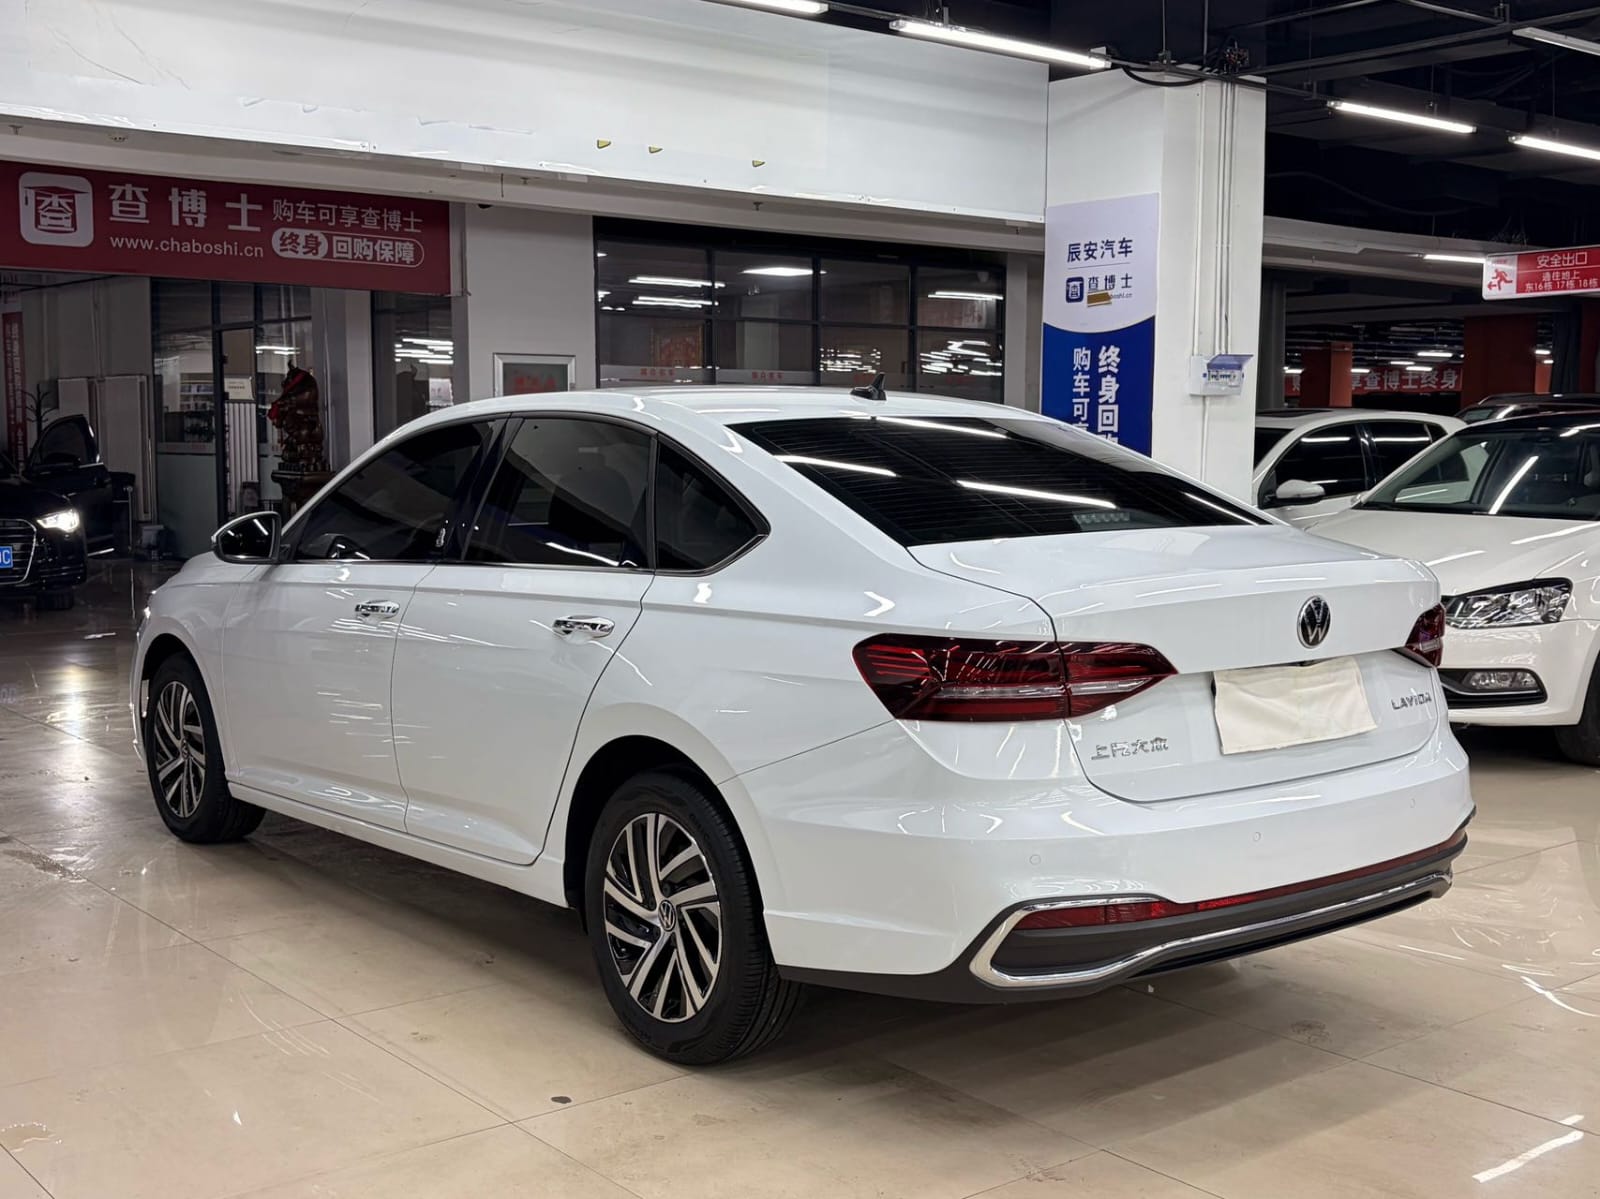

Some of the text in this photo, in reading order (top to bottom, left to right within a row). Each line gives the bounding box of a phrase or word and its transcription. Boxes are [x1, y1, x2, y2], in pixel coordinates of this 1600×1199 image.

[108, 183, 263, 232] 查博士
[272, 199, 423, 233] 购车可享查博士
[110, 235, 264, 258] www.chaboshi.cn
[278, 230, 416, 264] 终身回购保障
[1067, 237, 1133, 263] 辰安汽车
[1537, 252, 1588, 268] 安全出口
[1088, 273, 1133, 292] 查博士
[1390, 692, 1432, 710] LAVIDA
